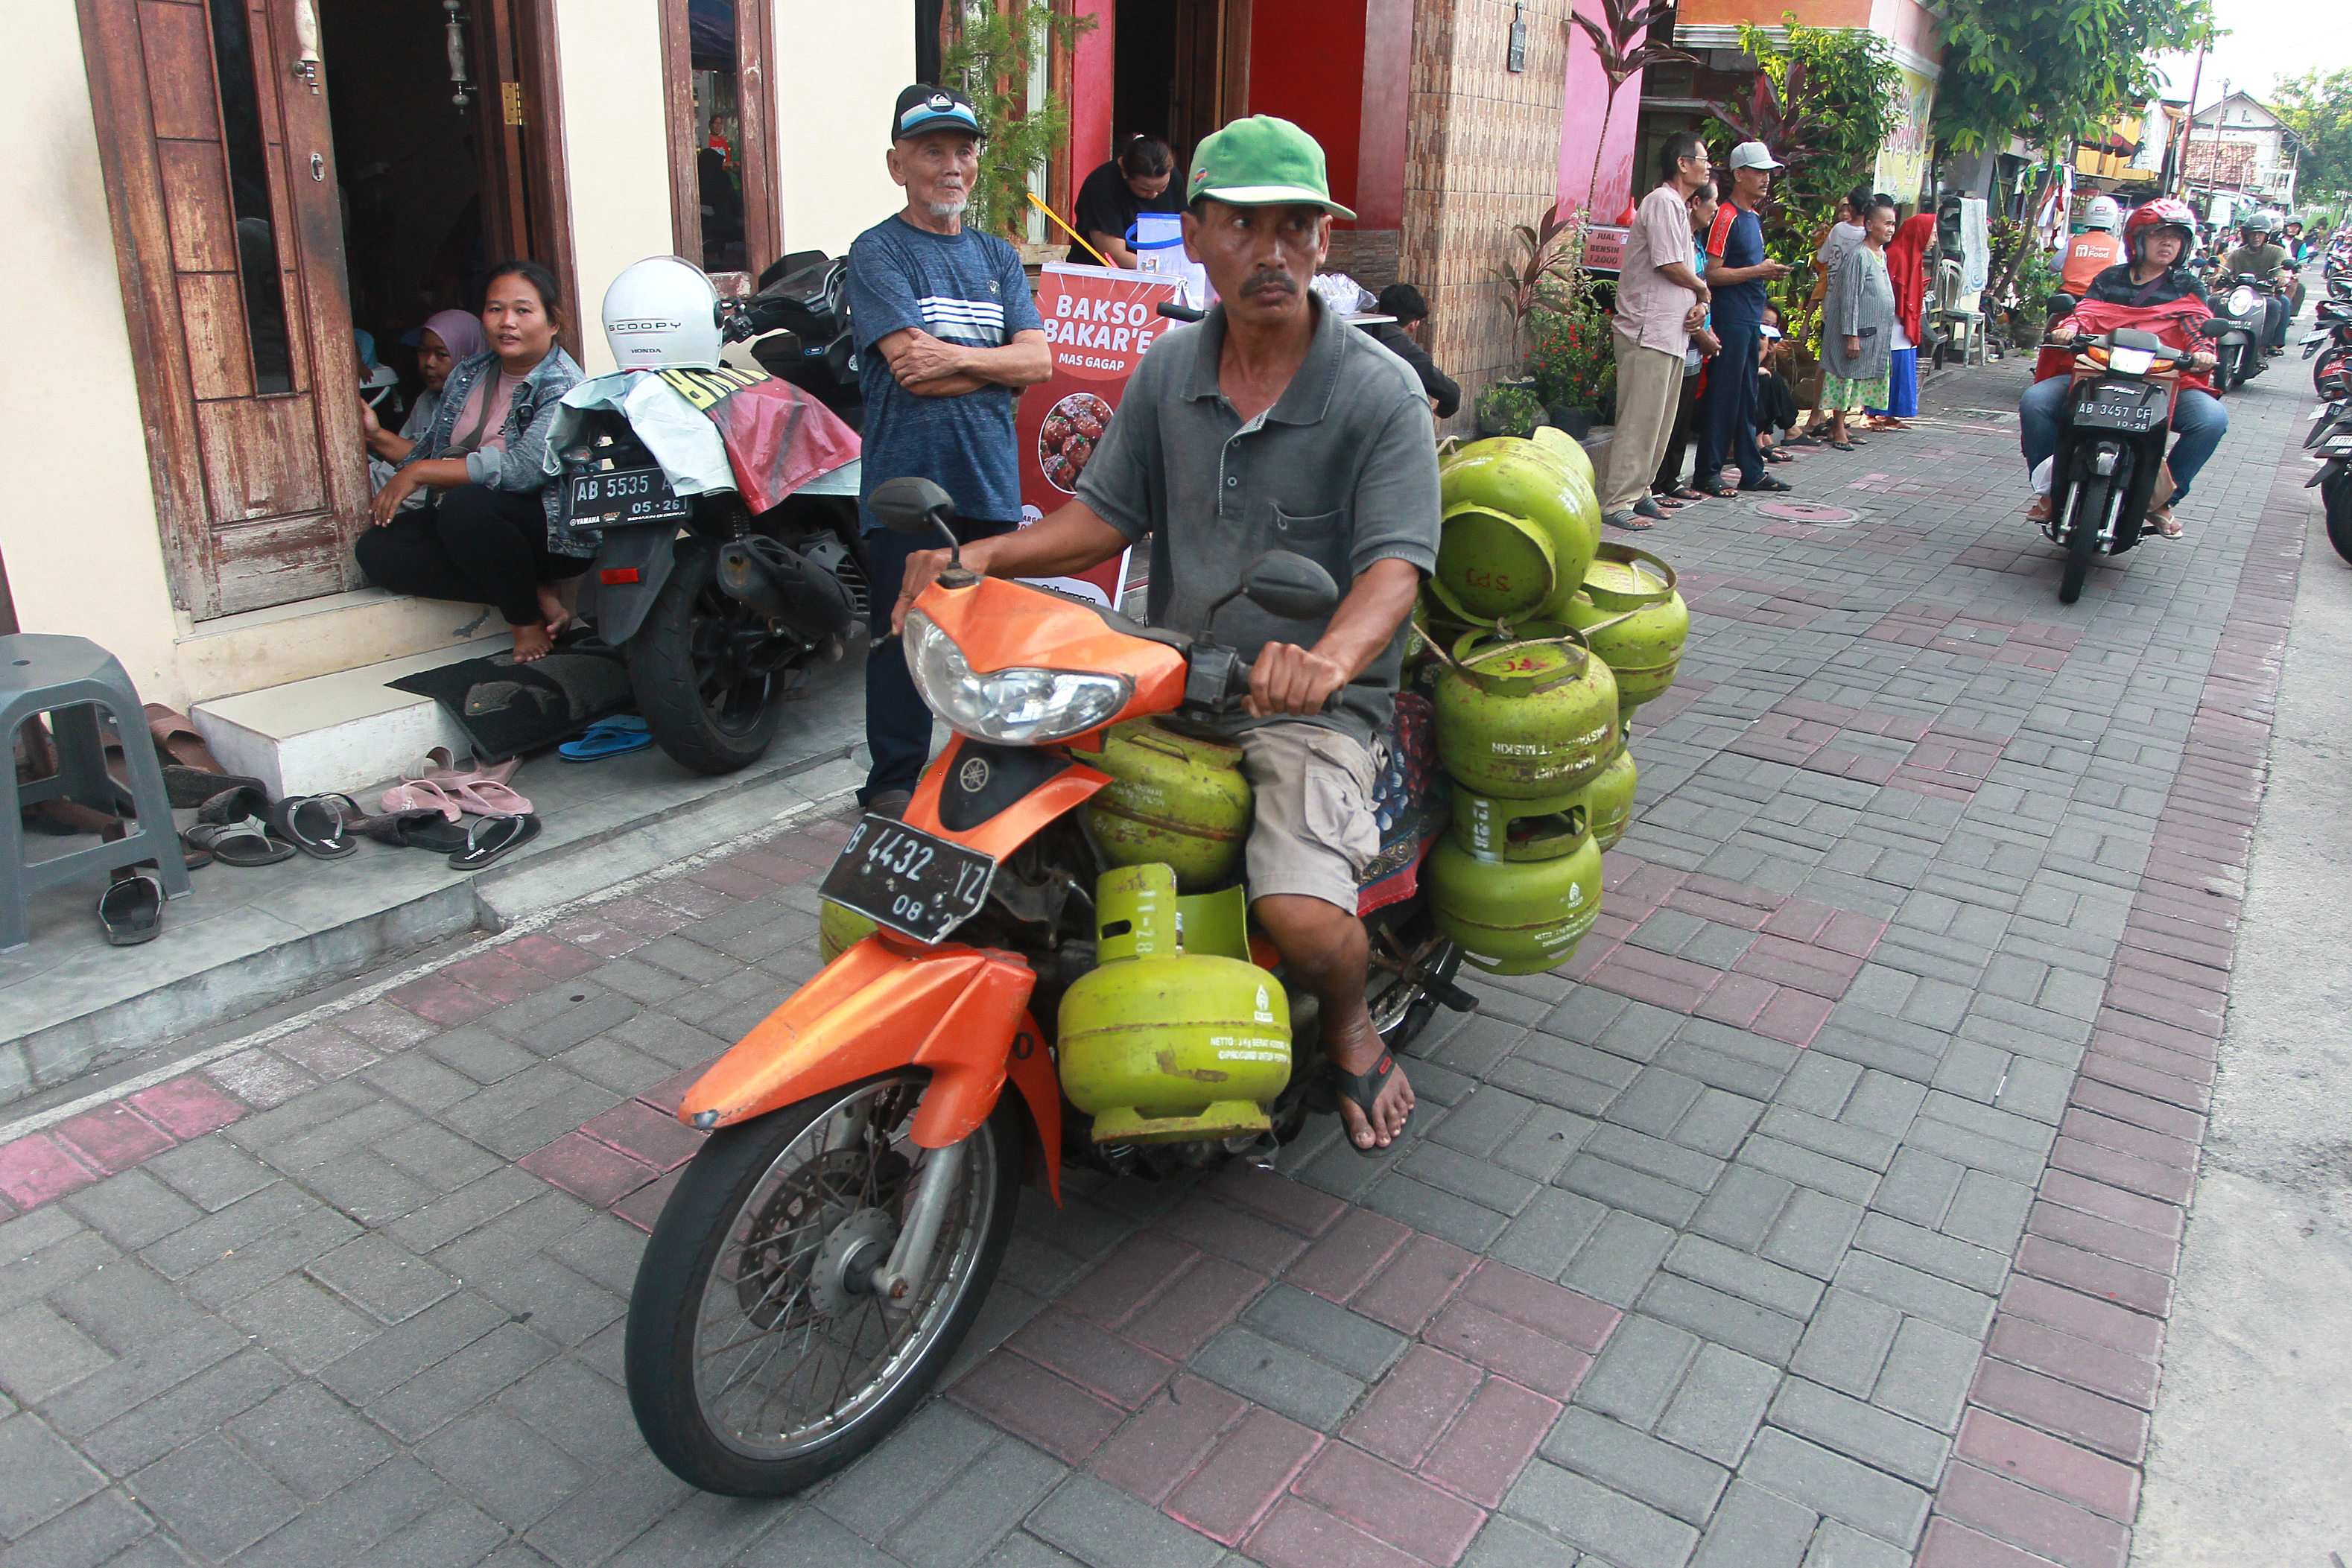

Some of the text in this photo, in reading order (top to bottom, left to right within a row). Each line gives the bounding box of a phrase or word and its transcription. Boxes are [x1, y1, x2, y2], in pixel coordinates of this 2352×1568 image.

[1597, 232, 1616, 241] JUAL
[1590, 244, 1620, 253] BENSIN
[2088, 250, 2109, 258] Food
[1056, 294, 1148, 326] BAKSO
[609, 322, 682, 331] SCOOPY
[1043, 318, 1154, 355] BAKAR'E
[1058, 353, 1125, 371] MAS GAGAP
[2078, 403, 2152, 419] AB 3457 CF
[2327, 406, 2341, 416] AB
[577, 480, 598, 501] AB
[606, 474, 649, 498] 5535
[576, 515, 600, 526] YAMAHA
[1491, 742, 1535, 755] MISKIN
[844, 823, 986, 905] B 4432 YZ
[1210, 1037, 1234, 1047] NETTO
